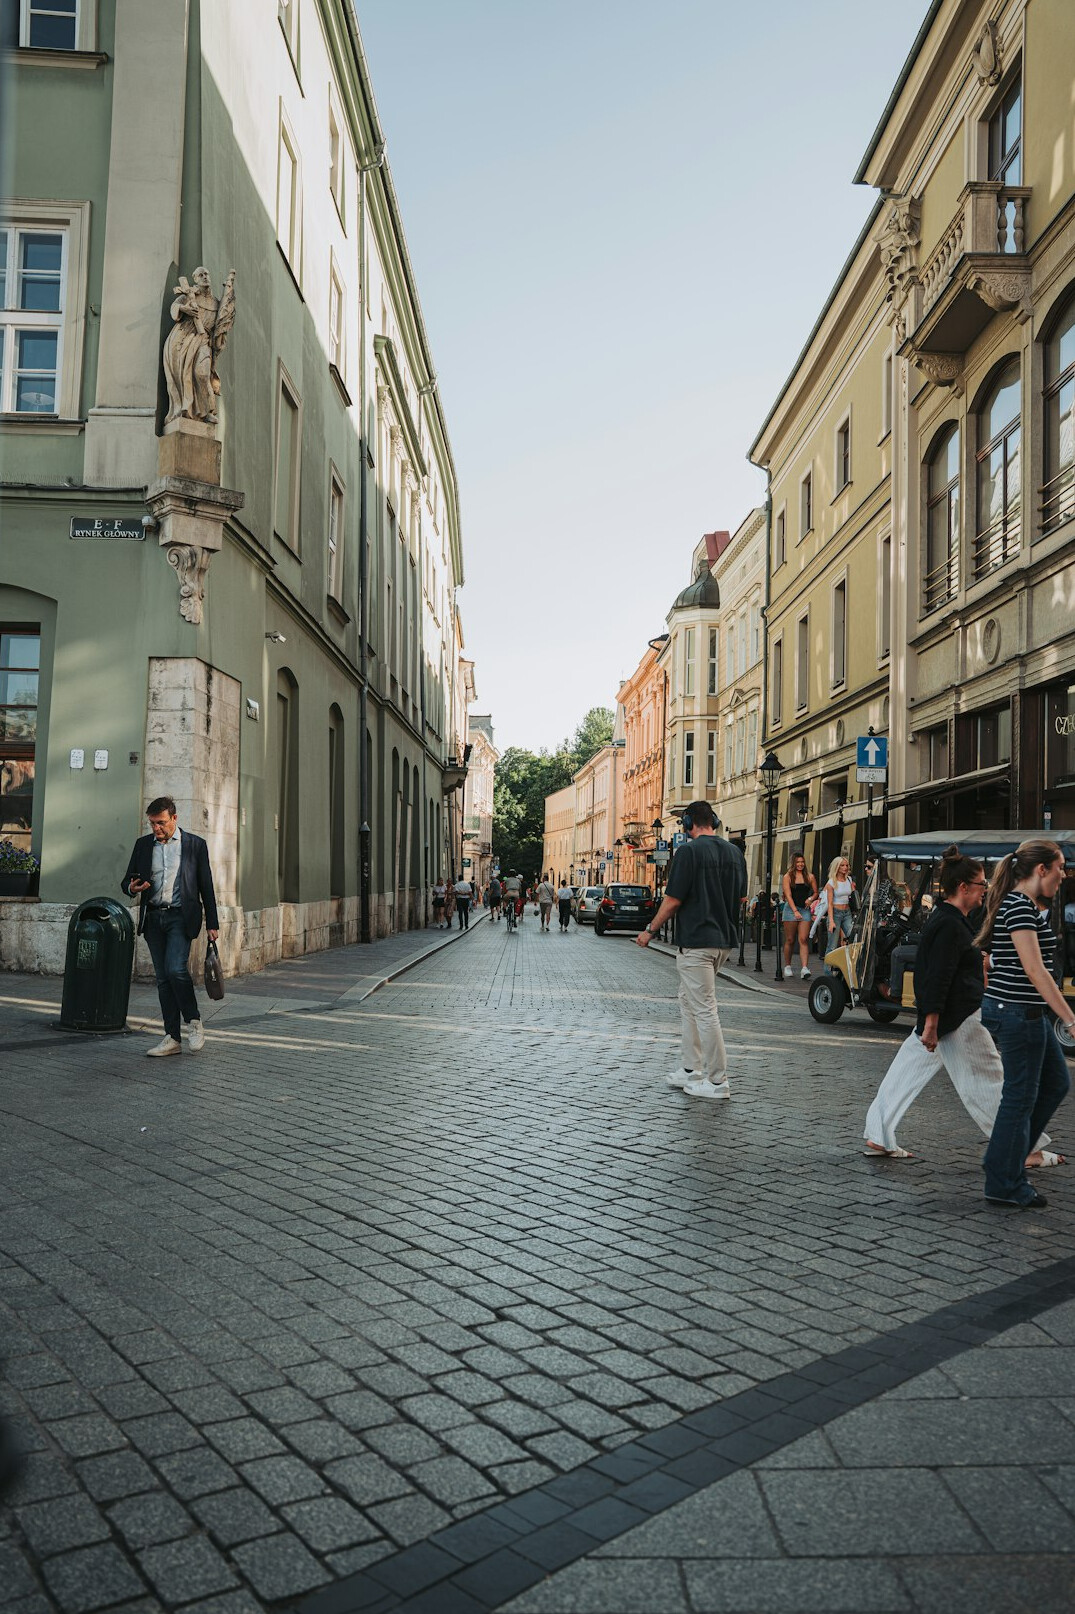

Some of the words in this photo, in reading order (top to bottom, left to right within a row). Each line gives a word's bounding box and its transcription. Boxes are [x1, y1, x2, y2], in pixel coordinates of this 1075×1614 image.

[94, 519, 103, 529] E
[114, 520, 123, 530] F
[104, 529, 140, 538] GŁÓWNY
[676, 833, 684, 844] P
[658, 841, 666, 850] P
